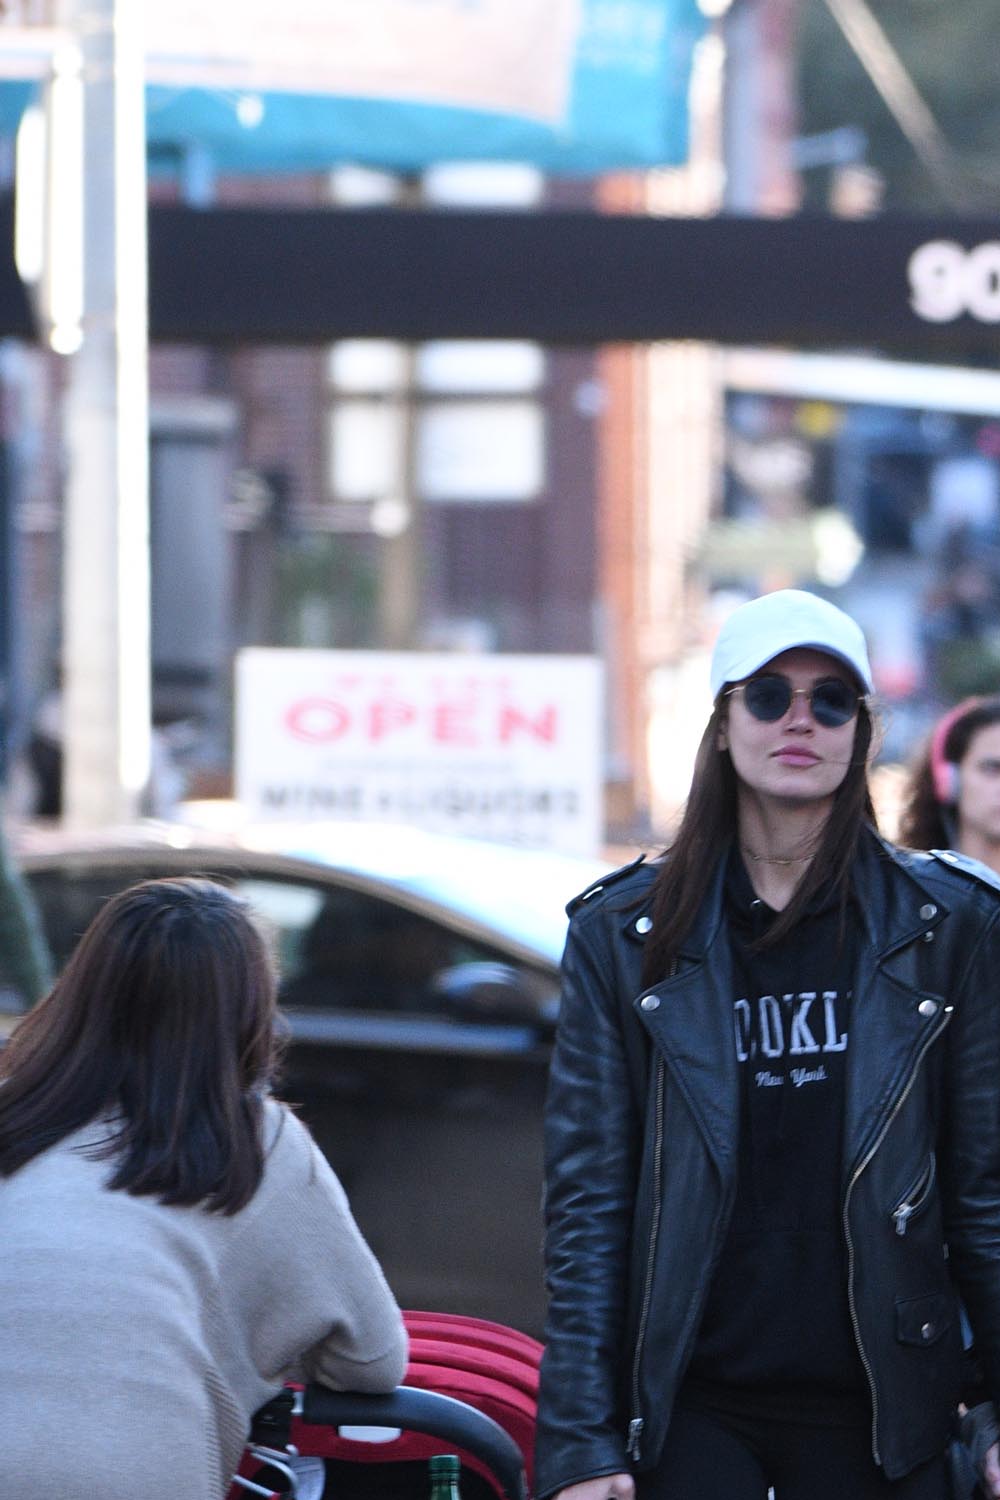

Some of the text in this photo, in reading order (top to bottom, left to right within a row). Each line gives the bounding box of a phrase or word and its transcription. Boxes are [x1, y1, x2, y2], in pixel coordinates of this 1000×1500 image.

[284, 699, 559, 746] OPEN
[755, 1064, 828, 1088] New York
